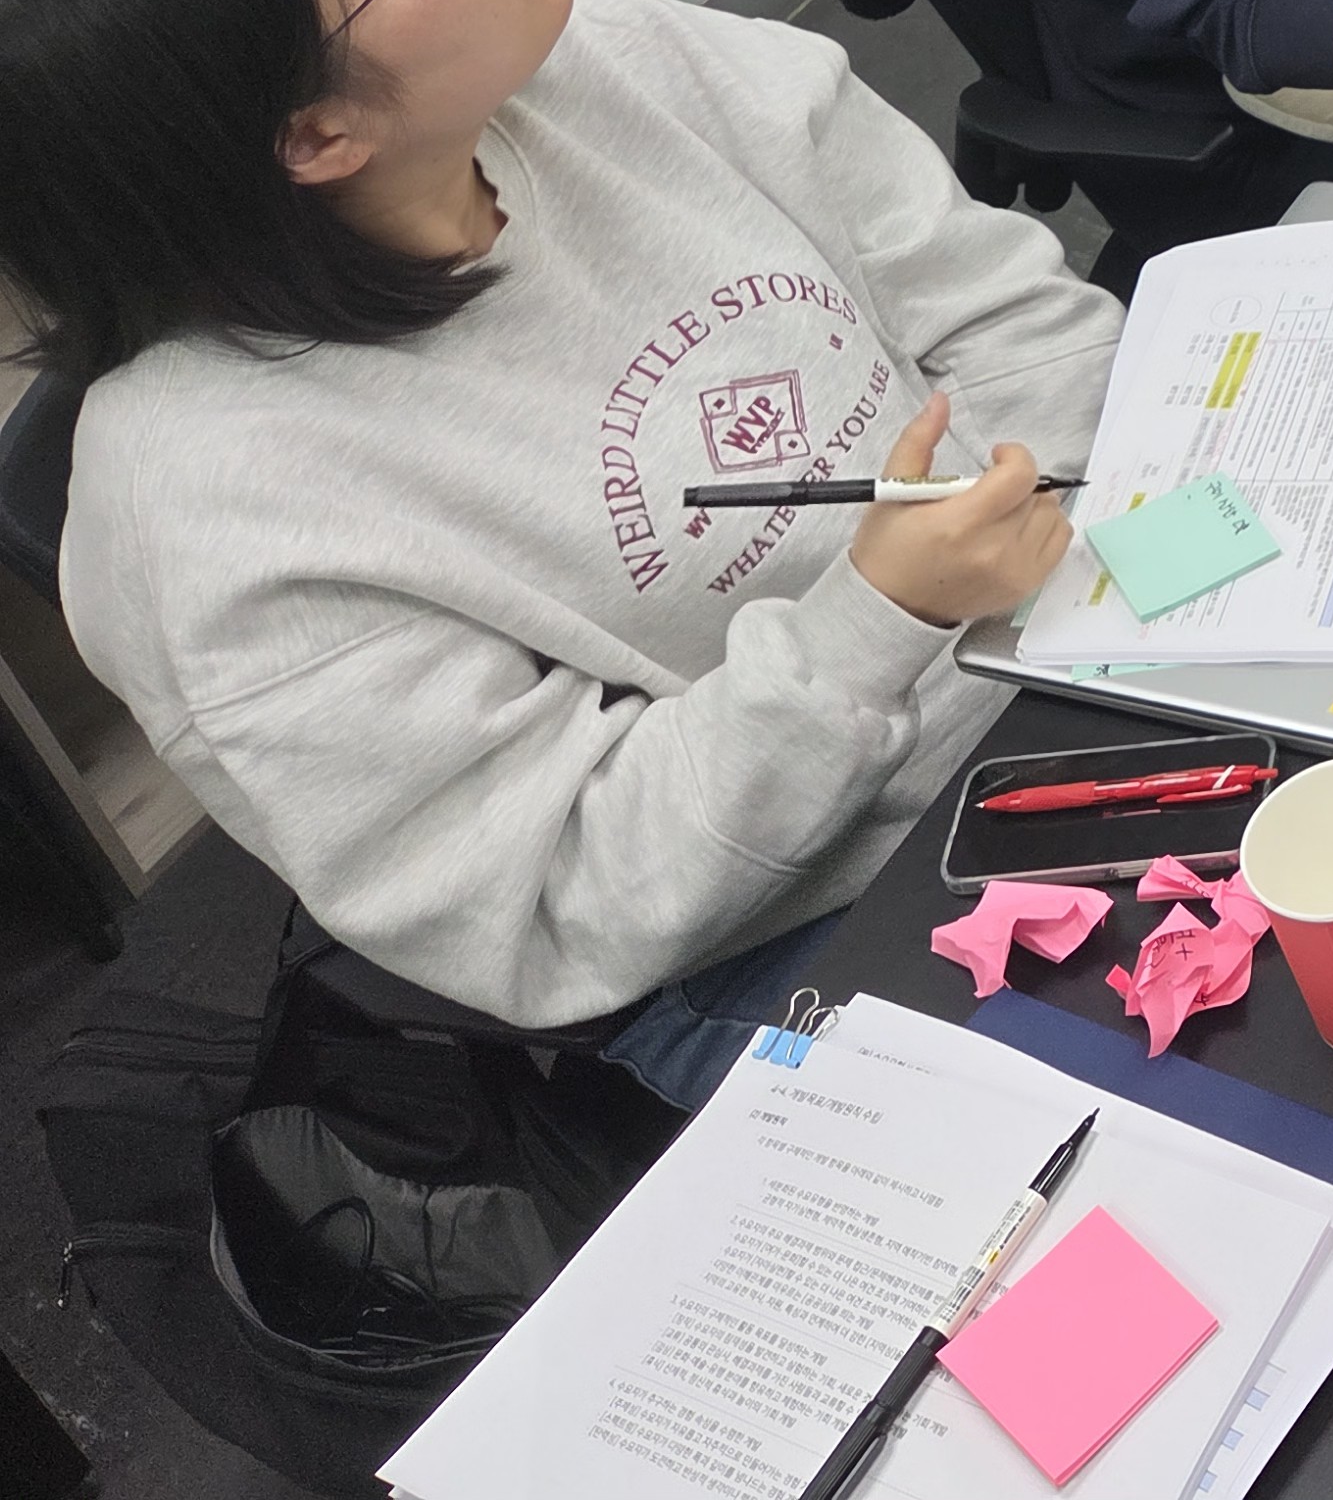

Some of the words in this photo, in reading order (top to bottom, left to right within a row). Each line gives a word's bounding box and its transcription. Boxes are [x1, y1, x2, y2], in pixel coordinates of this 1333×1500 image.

[711, 272, 858, 325] STORES
[601, 310, 711, 441] LITTLE
[707, 457, 835, 595] WHATEER
[826, 395, 878, 453] YOU
[865, 359, 890, 405] ARE
[600, 444, 670, 594] WEIRD
[862, 1213, 880, 1227] 개발
[815, 1263, 832, 1278] 있는
[802, 1276, 819, 1291] 있는
[810, 1351, 828, 1367] 개발
[743, 1436, 762, 1452] 개발
